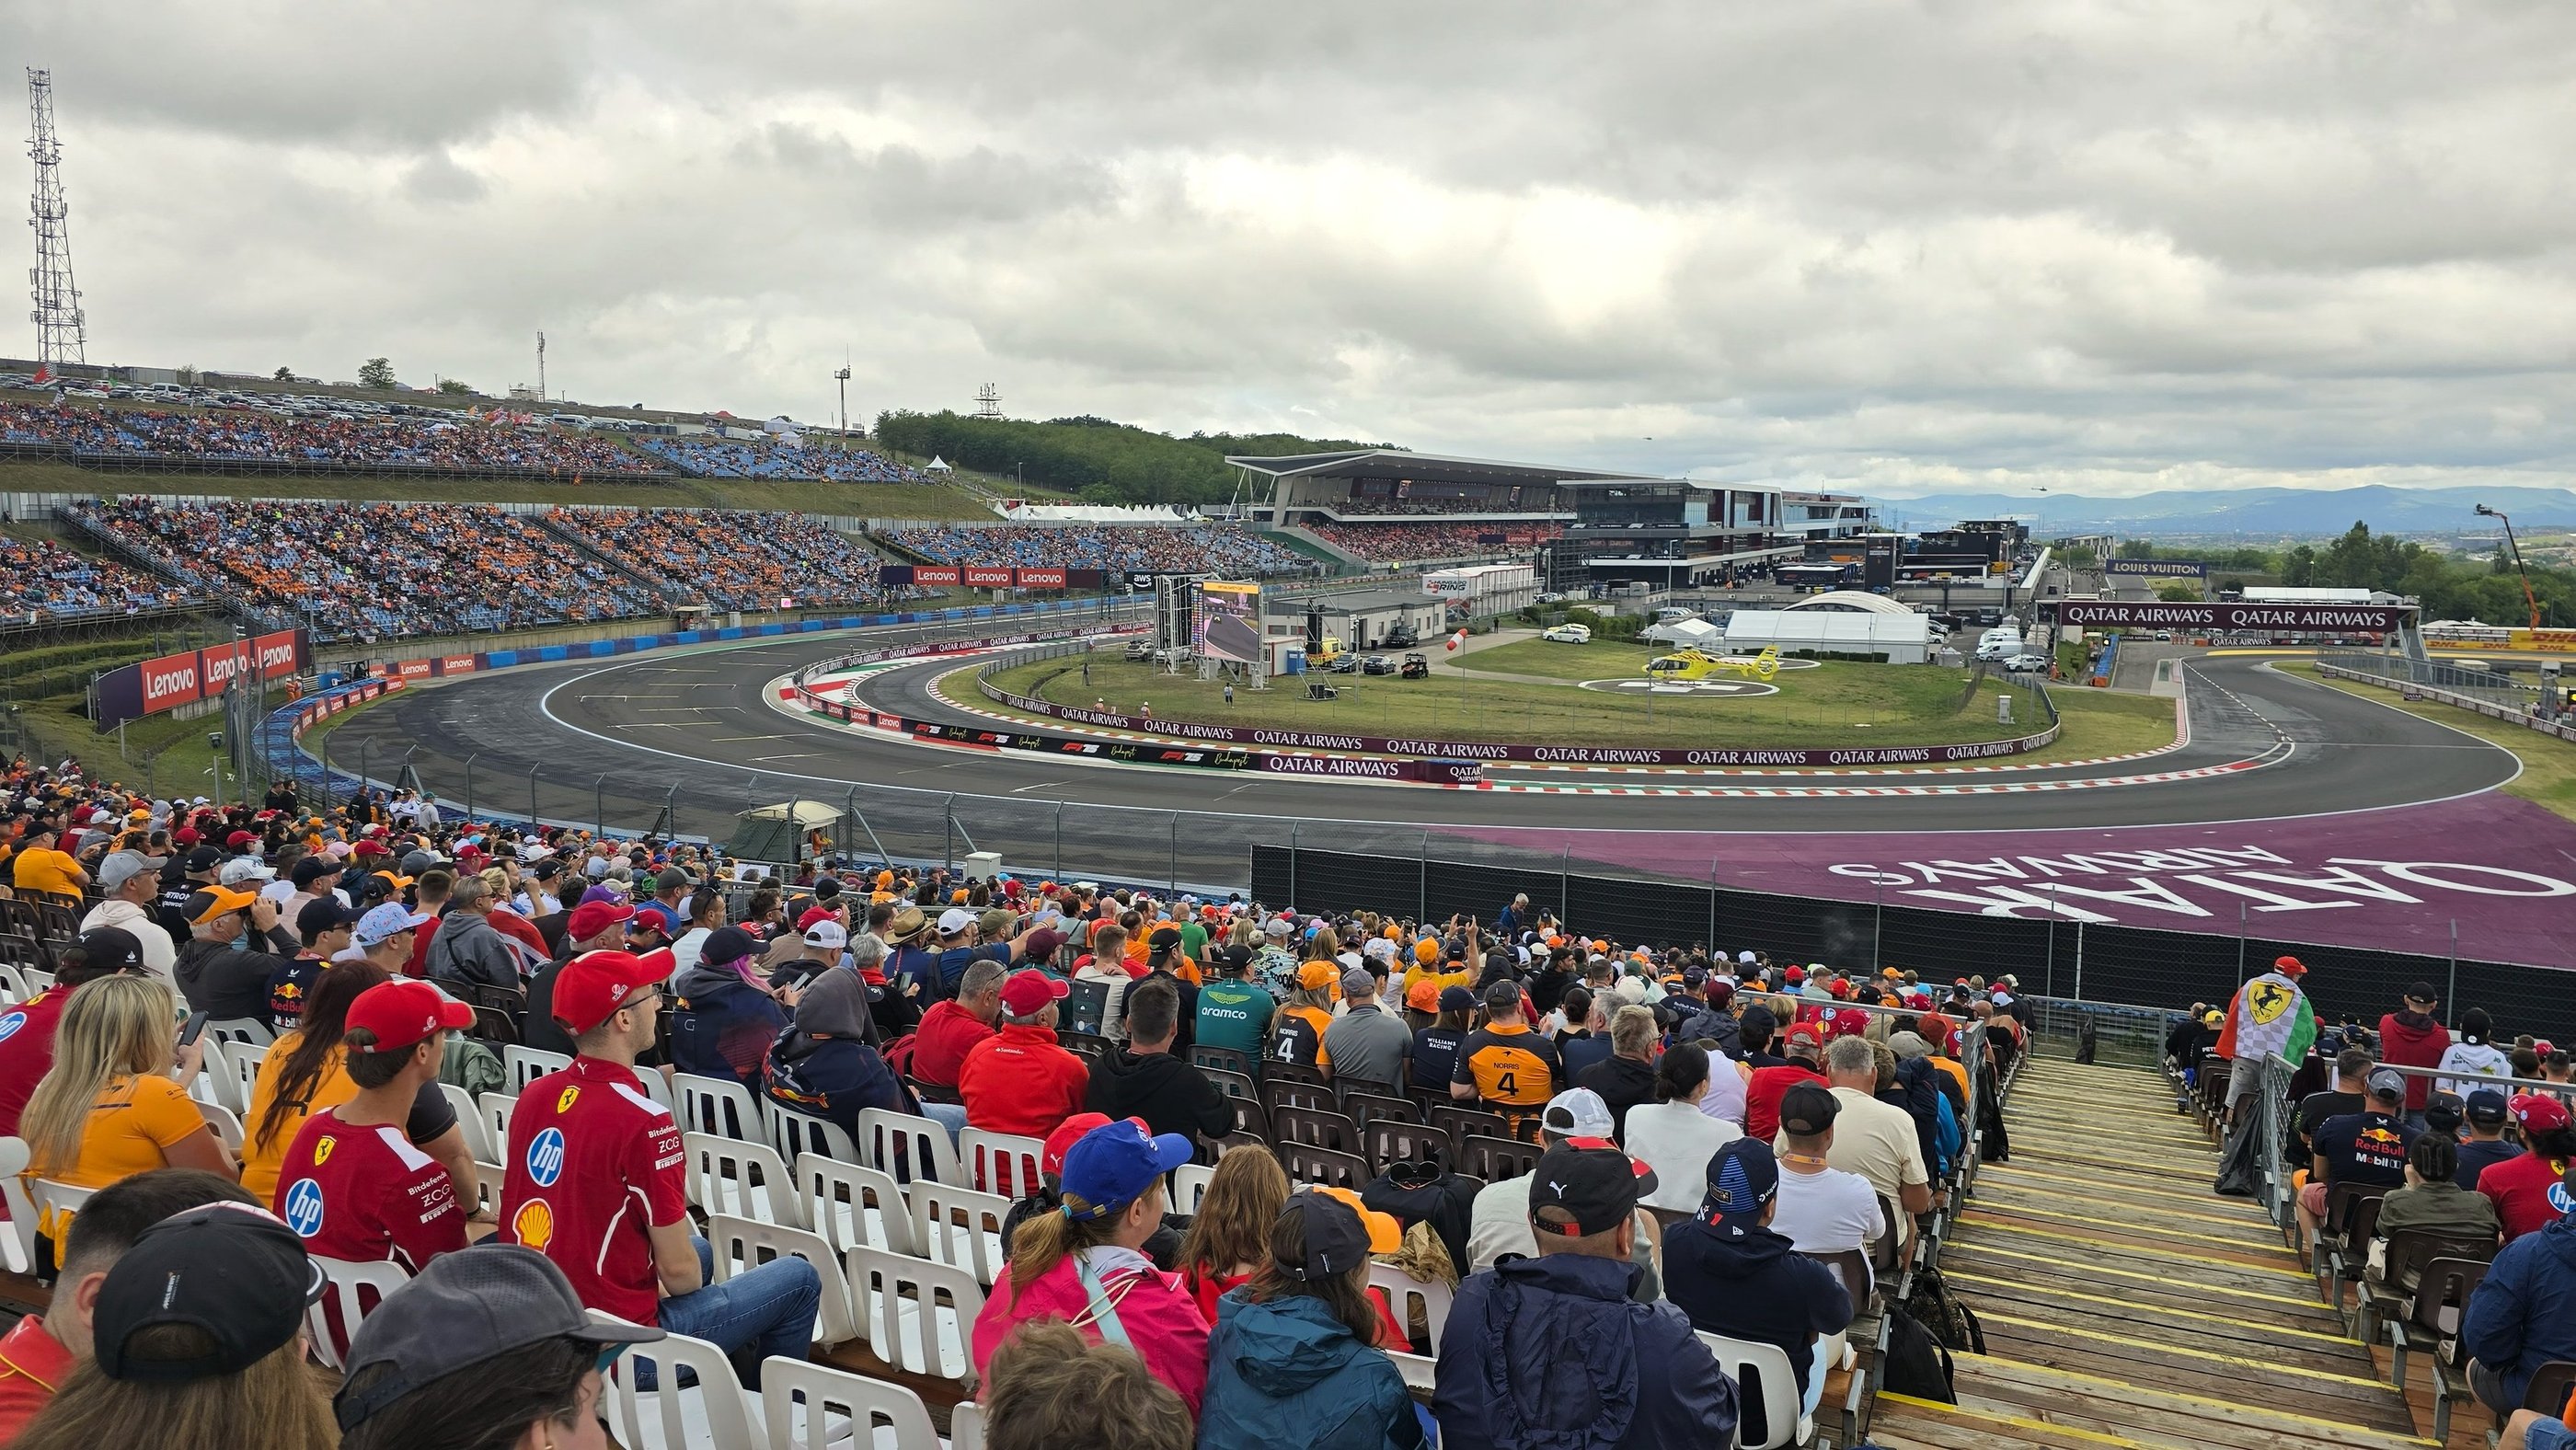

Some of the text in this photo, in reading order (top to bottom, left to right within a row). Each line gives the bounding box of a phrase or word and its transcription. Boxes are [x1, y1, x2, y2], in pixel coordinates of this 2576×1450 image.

[917, 570, 957, 581] Lenovo
[2114, 562, 2201, 575] LOUIS VUITTON
[969, 570, 1009, 582] Lenovo
[1021, 570, 1062, 583] Lenovo
[1133, 574, 1152, 582] aws
[2069, 607, 2214, 623] QATAR AIRWAYS
[2231, 610, 2386, 627] QATAR AIRWAYS
[1036, 629, 1074, 641] QATAR AIRWAYS
[1079, 626, 1113, 637] QATAR AIRWAYS
[938, 639, 983, 652] QATAR AIRWAYS
[990, 635, 1030, 646] QATAR AIRWAYS
[2214, 638, 2272, 647] QATAR AIRWAYS
[258, 643, 293, 670] Lenovo
[848, 651, 883, 667] QATAR AIRWAYS
[889, 645, 930, 659] QATAR AIRWAYS
[401, 662, 429, 674] Lenovo
[445, 657, 473, 669] Lenovo
[146, 667, 195, 699] Lenovo
[387, 680, 402, 690] Lenovo
[364, 686, 379, 697] Lenovo
[331, 699, 344, 711] Lenovo
[828, 703, 843, 716] Lenovo
[1007, 696, 1051, 715] QATAR AIRWAYS
[851, 709, 868, 722] Lenovo
[879, 715, 900, 729] Lenovo
[1061, 708, 1129, 728] QATAR AIRWAYS
[1144, 720, 1234, 740] QATAR AIRWAYS
[1254, 730, 1363, 750] QATAR AIRWAYS
[2022, 735, 2040, 751] QATAR
[1386, 740, 1508, 758] QATAR AIRWAYS
[1535, 747, 1662, 763] QATAR AIRWAYS
[1947, 742, 2014, 760] QATAR AIRWAYS
[1687, 751, 1807, 765] QATAR AIRWAYS
[1829, 749, 1929, 765] QATAR AIRWAYS
[1270, 756, 1399, 777] QATAR AIRWAYS
[1450, 766, 1481, 777] QATAR
[1829, 846, 2293, 886] AIRWAYS
[1897, 857, 2576, 923] QATAR
[270, 998, 289, 1011] Red
[1202, 1007, 1248, 1020] aramco
[274, 1014, 295, 1028] Mobil
[1279, 1028, 1299, 1037] NORRIS
[1427, 1037, 1456, 1046] WILLIAMS
[1429, 1042, 1453, 1051] RACING
[1278, 1037, 1294, 1063] 4
[1493, 1062, 1520, 1070] NORRIS
[1498, 1072, 1520, 1097] 4
[648, 1124, 678, 1139] Bitdefend
[659, 1136, 680, 1154] ZCG
[2355, 1138, 2405, 1157] Red Bull
[532, 1129, 562, 1184] hp
[655, 1151, 684, 1170] PIRELLI
[2356, 1152, 2388, 1167] Mobil
[408, 1170, 447, 1196] Bitdefend
[421, 1183, 451, 1207] ZCG
[290, 1180, 321, 1234] hp
